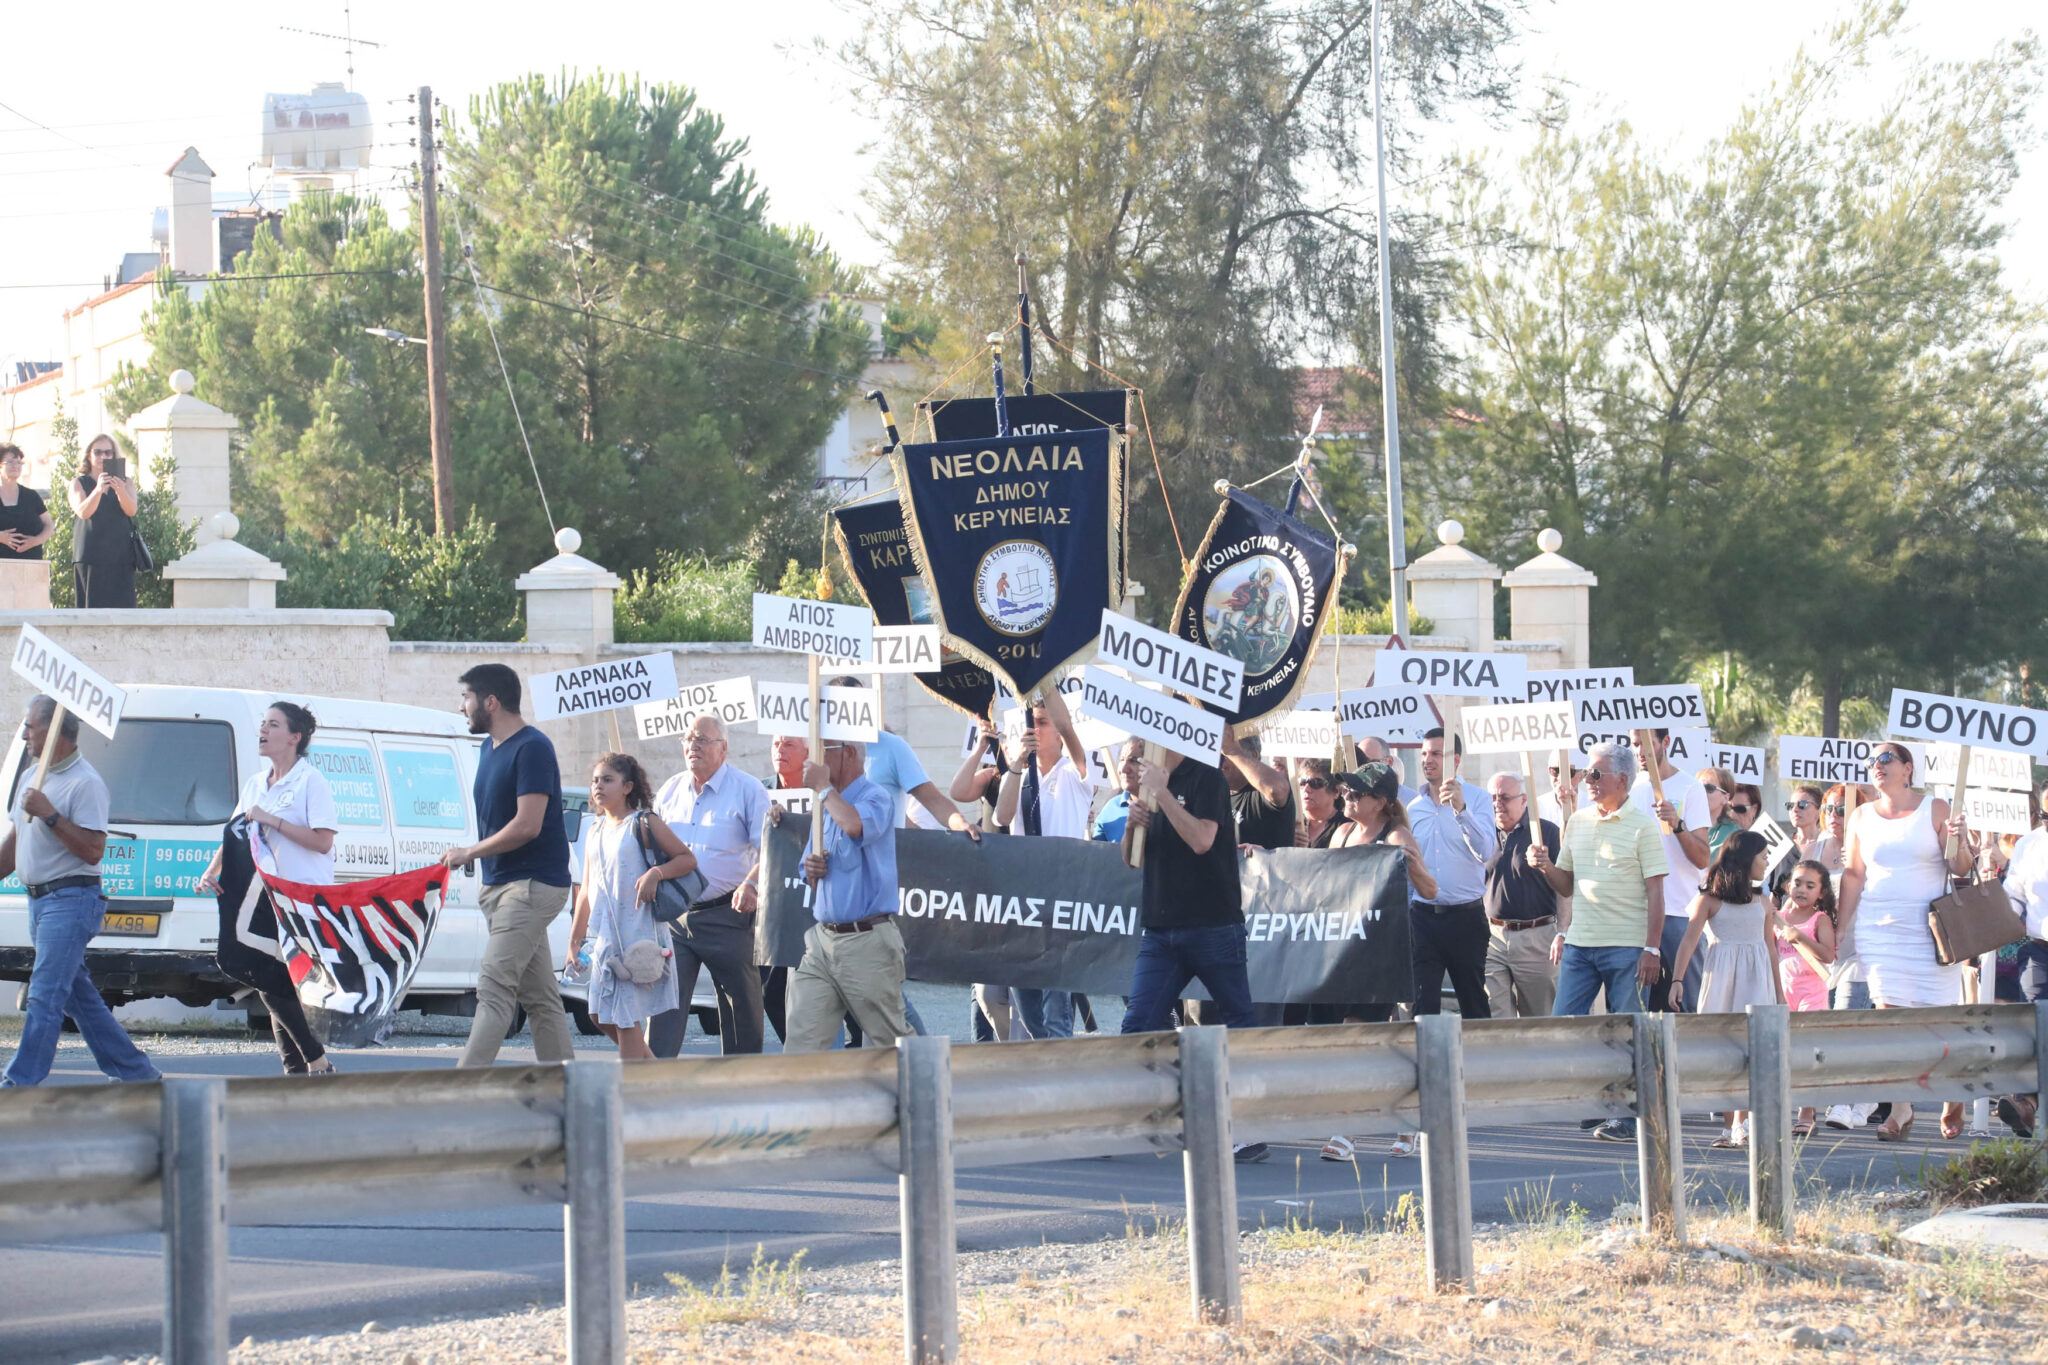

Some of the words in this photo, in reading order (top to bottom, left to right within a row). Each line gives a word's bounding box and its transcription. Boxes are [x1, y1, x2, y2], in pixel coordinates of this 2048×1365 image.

[930, 445, 1084, 480] ΝΕΟΛΑΙΑ
[975, 481, 1050, 504] ΔΗΜΟΥ
[954, 506, 1071, 531] ΚΕΡΥΝΕΙΑΣ
[859, 528, 908, 547] ΣΥΝΤΟΝΙΣ
[870, 544, 909, 569] ΚΑΡ
[977, 559, 991, 604] ΔΗΜΟΤΙΚΟ
[990, 543, 1036, 561] ΣΥΜΒΟΥΛΙΟ
[1203, 535, 1279, 574] ΚΟΙΝΟΤΙΚΟ
[1279, 541, 1316, 627] ΣΥΜΒΟΥΛΙΟ
[788, 603, 835, 628] ΑΓΙΟΣ
[987, 614, 1015, 631] ΔΗΜΟΥ
[763, 626, 861, 658] ΑΜΒΡΟΣΙΟΣ
[820, 635, 933, 667] ΤΖΙΑ
[555, 660, 649, 692] ΛΑΡΝΑΚΑ
[1102, 624, 1237, 701] ΜΟΤΙΔΕΣ
[1401, 658, 1500, 687] ΟΡΚΑ
[17, 635, 114, 727] ΠΑΝΑΓΡΑ
[1247, 657, 1298, 697] ΚΕΡΥΝΕΙΑΣ
[557, 680, 652, 714] ΛΑΠΗΘΟΥ
[666, 684, 718, 711] ΑΓΙΟΣ
[1581, 695, 1701, 722] ΛΑΠΗΘΟΣ
[644, 702, 748, 737] ΕΡΜΟΟΣ
[1084, 682, 1219, 752] ΠΑΛΑΙΟΣΟΦΟΣ
[1466, 713, 1573, 745] ΚΑΡΑΒΑΣ
[1900, 698, 2036, 747] ΒΟΥΝΟ
[306, 752, 373, 775] ΡΙΖΟΝΤΑΙ:
[1820, 739, 1882, 761] ΑΓΙΟ
[1791, 759, 1869, 783] ΕΠΙΚΤΗ
[1940, 749, 2029, 780] ΚΑΠΑΣΙΑ
[330, 780, 376, 798] ΟΥΡΤΙΝΕΣ
[336, 801, 381, 820] ΟΥΒΕΡΤΕΣ
[1973, 801, 2027, 821] ΕΙΡΗΝΗ
[155, 848, 173, 862] 99
[176, 848, 217, 863] 6604
[345, 844, 356, 864] 99
[358, 846, 389, 865] 478992
[154, 875, 172, 889] 99
[115, 917, 145, 932] 498
[975, 894, 1045, 928] ΜΑΣ
[1052, 901, 1138, 936] ΕΙΝΑΙ
